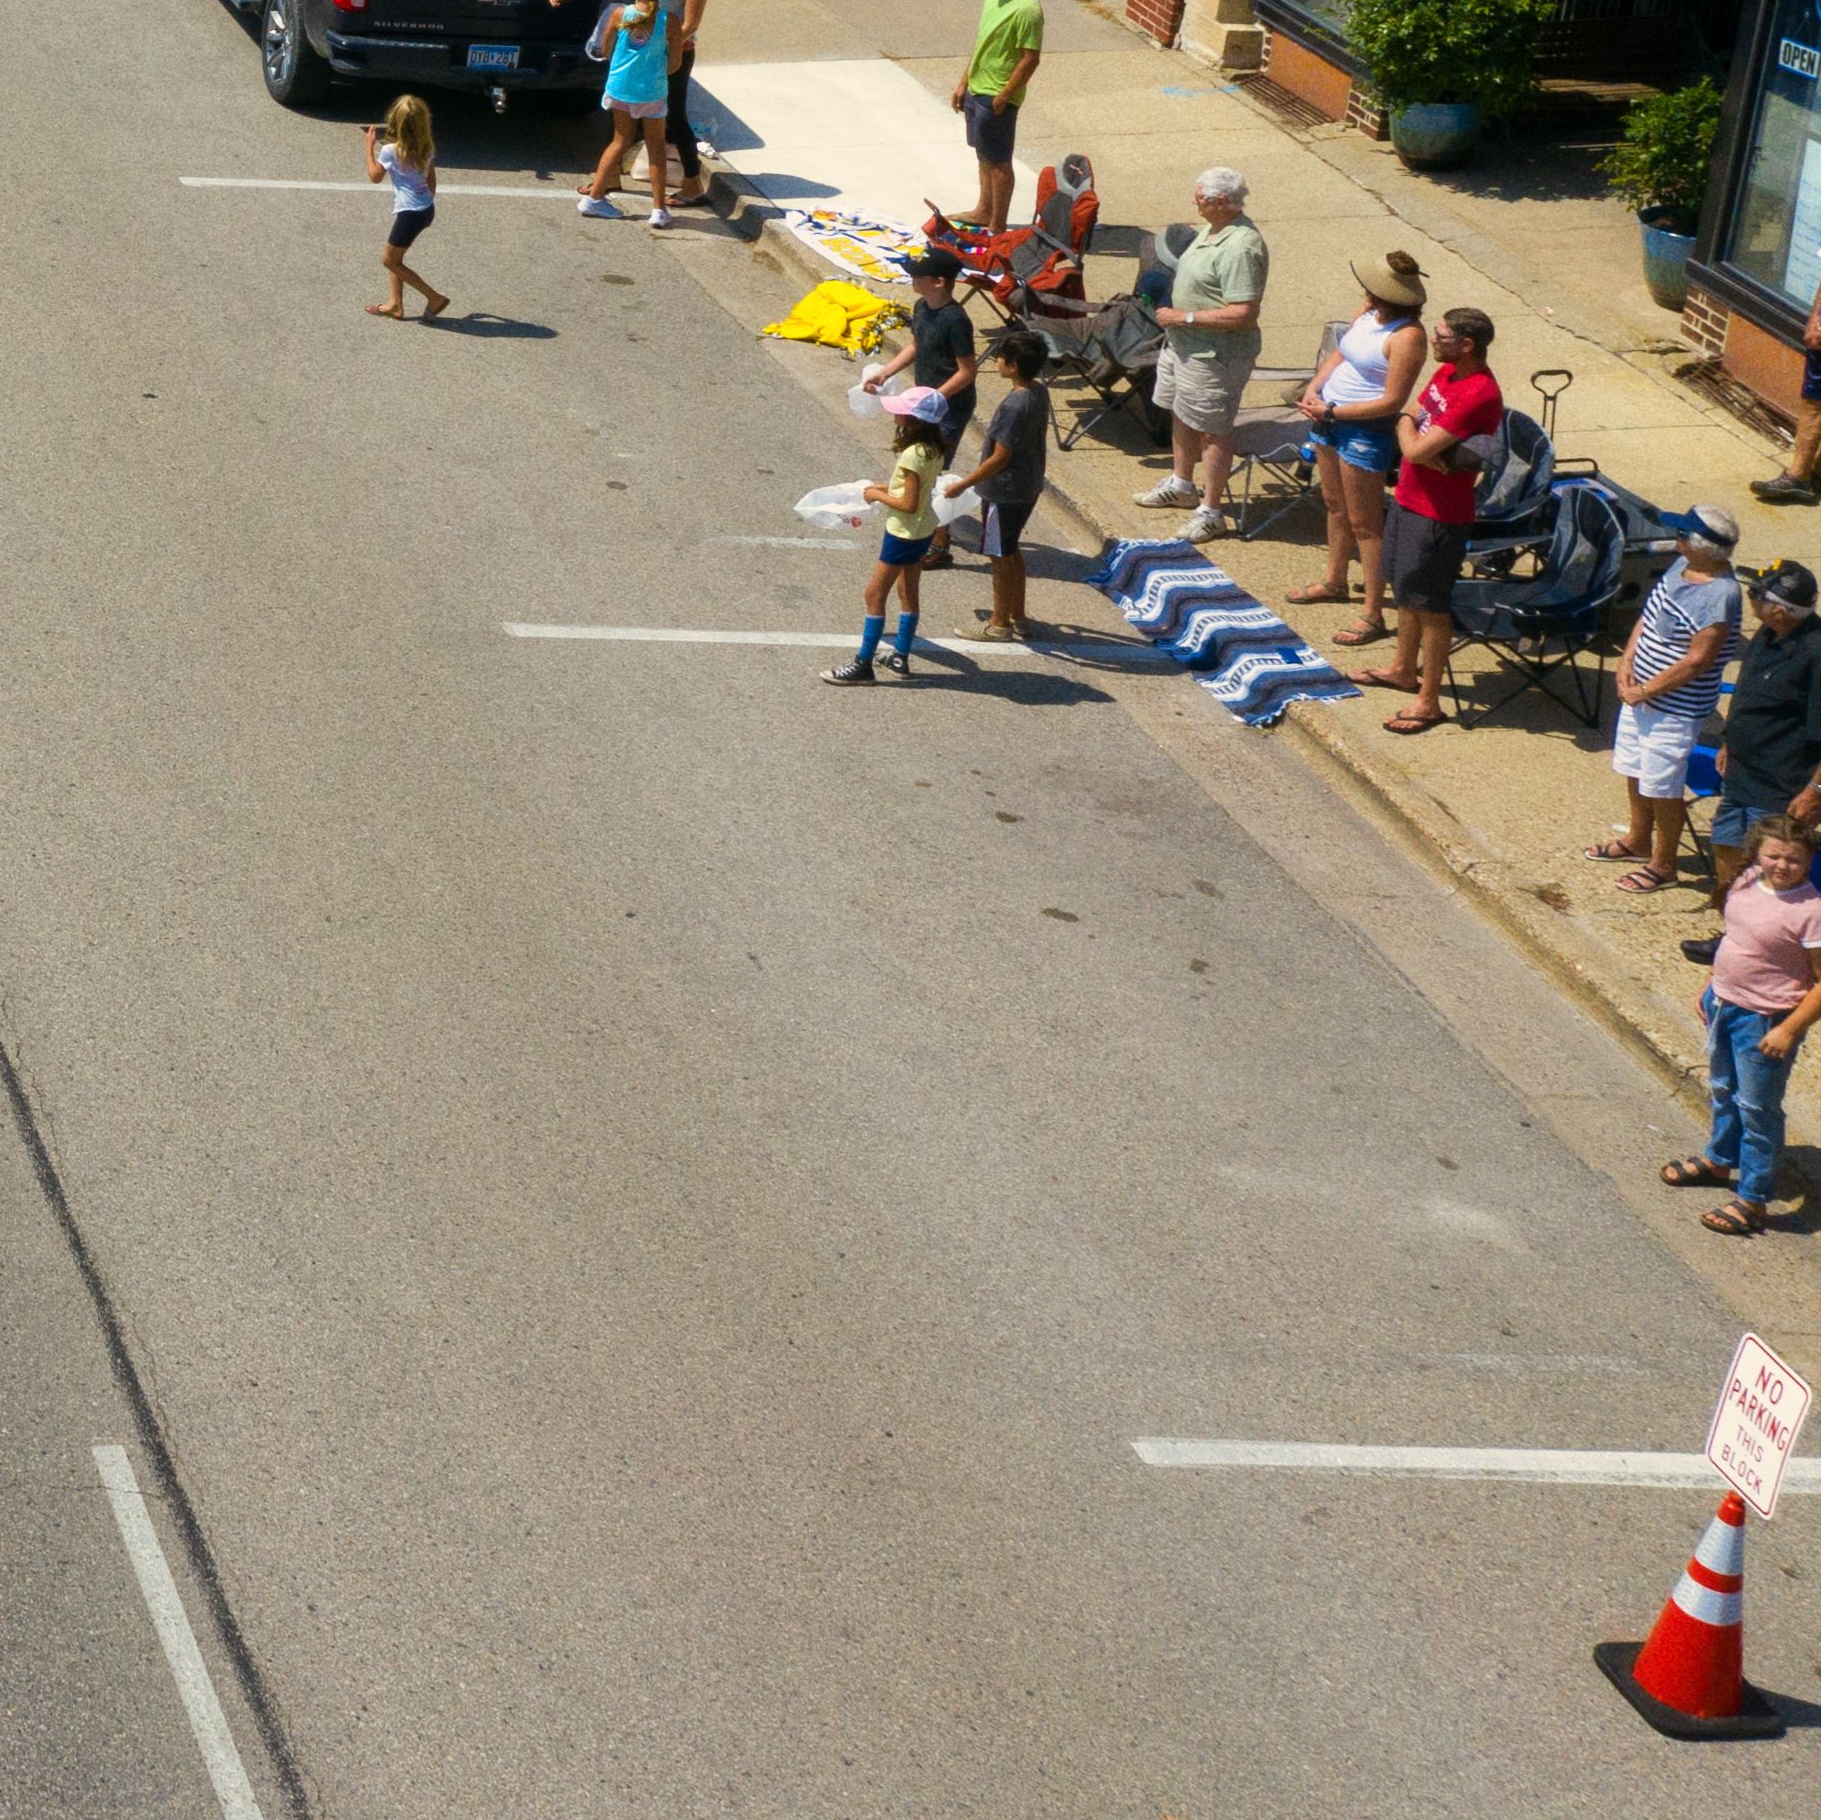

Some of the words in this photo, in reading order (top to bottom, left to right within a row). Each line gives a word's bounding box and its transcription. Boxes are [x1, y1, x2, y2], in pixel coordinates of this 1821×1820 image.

[374, 21, 444, 30] SILVERADO
[1781, 39, 1819, 75] OPEN
[1758, 1365, 1783, 1405] NO
[1728, 1379, 1789, 1452] PARKING
[1736, 1424, 1764, 1463] THIS
[1721, 1443, 1762, 1495] BLOCK
